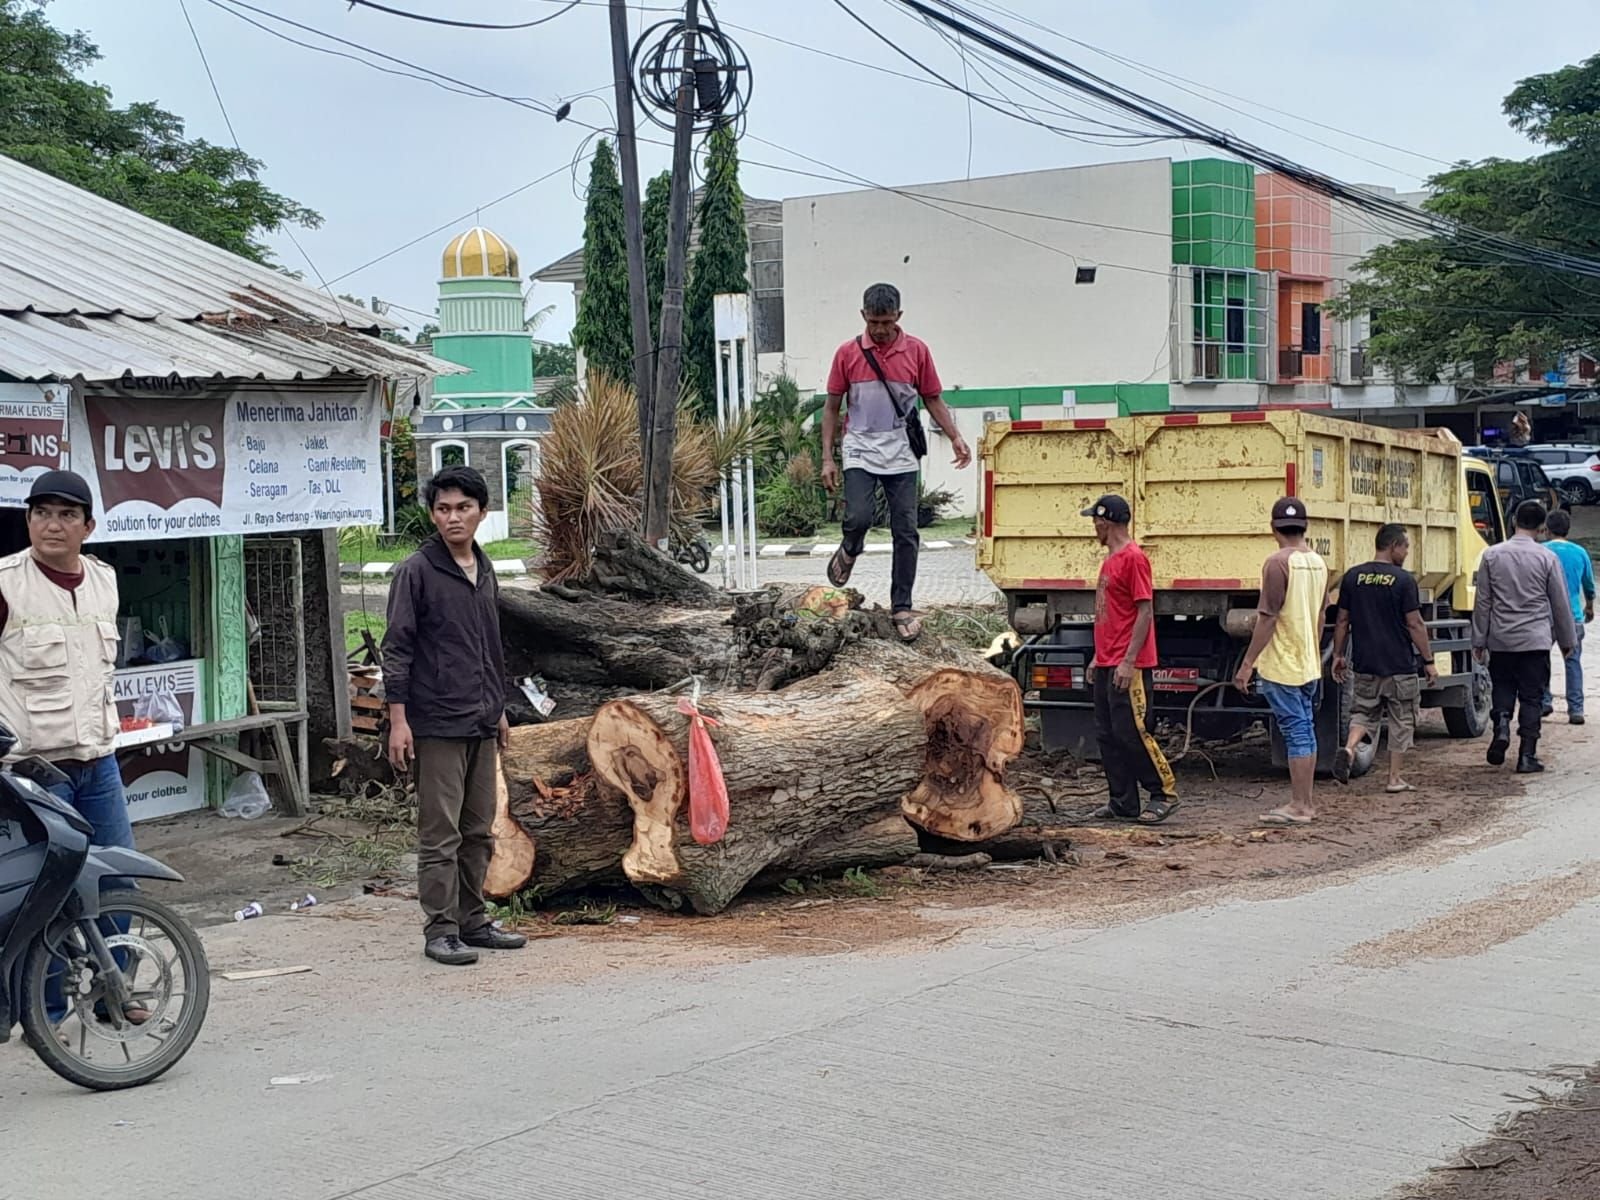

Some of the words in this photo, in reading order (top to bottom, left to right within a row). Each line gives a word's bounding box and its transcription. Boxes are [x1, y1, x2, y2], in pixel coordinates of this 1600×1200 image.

[26, 405, 52, 417] LEVIS
[236, 401, 305, 422] Menerima
[246, 436, 266, 454] Baju
[304, 435, 329, 450] Jaket
[248, 459, 279, 474] Celana
[307, 458, 330, 473] Ganti
[249, 482, 288, 500] Seragam
[325, 479, 342, 494] DLL
[107, 516, 146, 533] solution
[147, 513, 162, 531] for
[164, 516, 188, 533] your
[188, 512, 221, 528] clothes
[254, 512, 275, 527] Raya
[275, 511, 310, 525] Serdang
[1315, 538, 1330, 556] 2022
[137, 674, 177, 696] LEVIS
[126, 791, 150, 806] your
[151, 784, 188, 799] clothes
